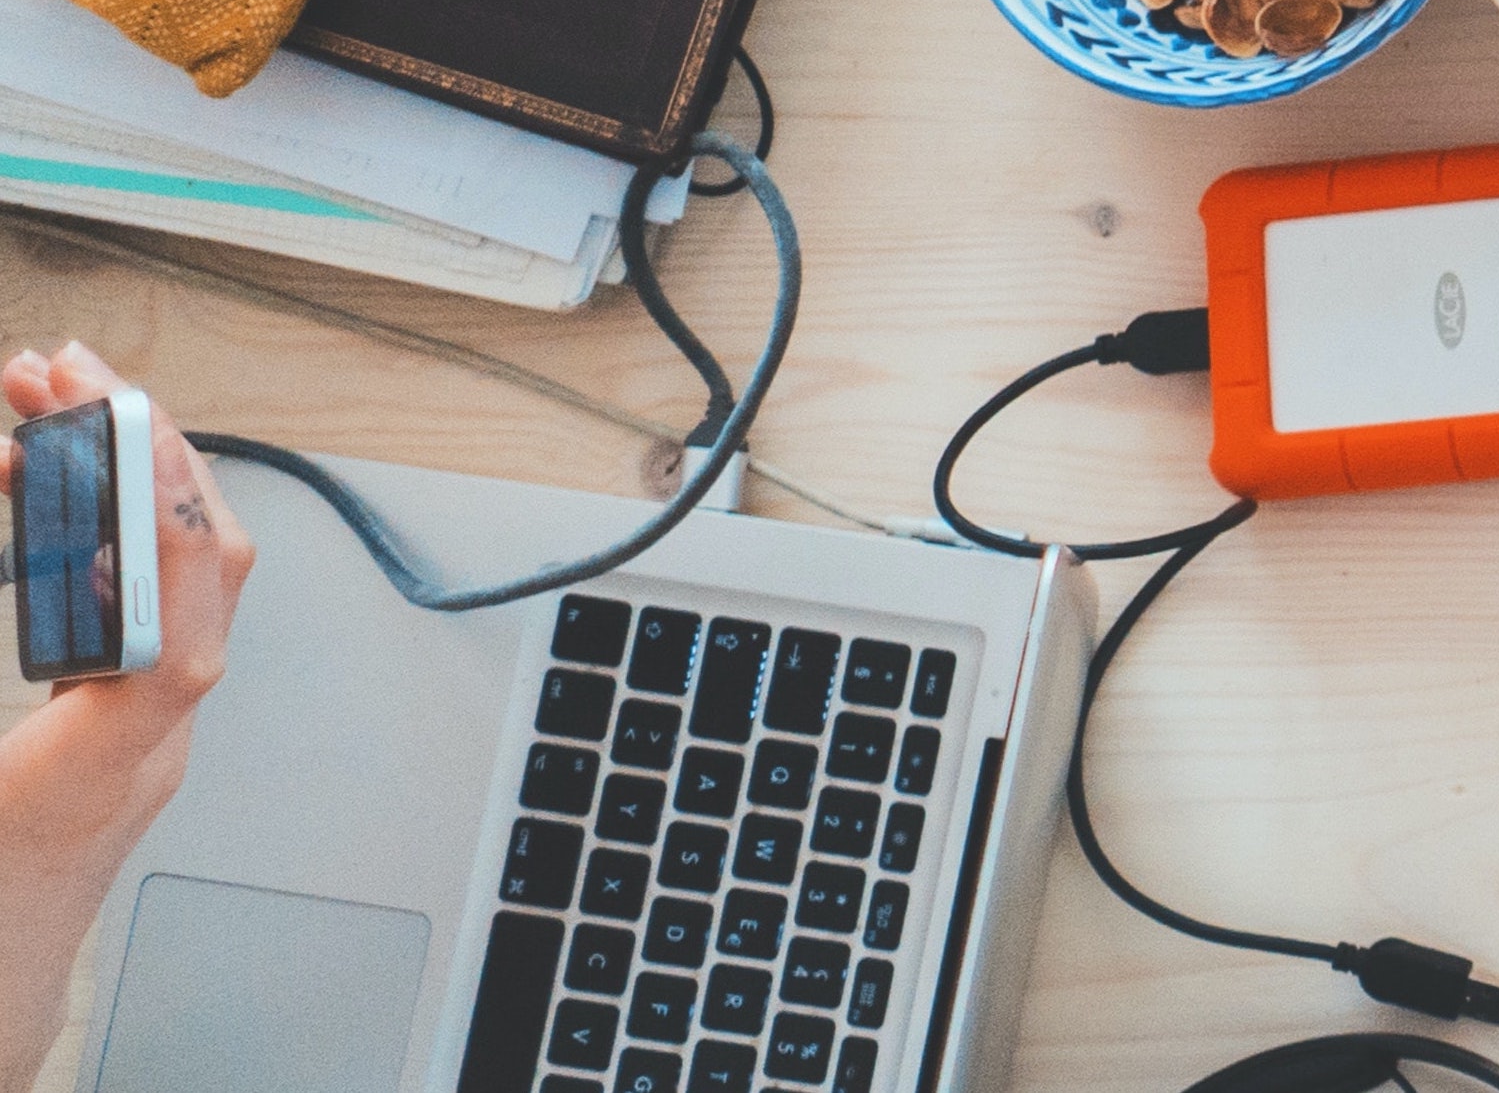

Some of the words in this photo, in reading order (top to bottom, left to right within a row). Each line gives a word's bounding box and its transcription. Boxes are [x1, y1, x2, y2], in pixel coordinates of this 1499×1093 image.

[697, 774, 717, 791] A
[769, 765, 791, 785] Q
[619, 803, 638, 818] Y
[680, 850, 701, 865] S
[754, 839, 776, 862] W
[603, 877, 622, 893] X
[738, 917, 759, 932] E
[665, 924, 686, 943] D
[587, 952, 607, 969] C
[723, 992, 745, 1009] R
[650, 1002, 670, 1017] F
[571, 1028, 591, 1045] V
[709, 1071, 730, 1084] T
